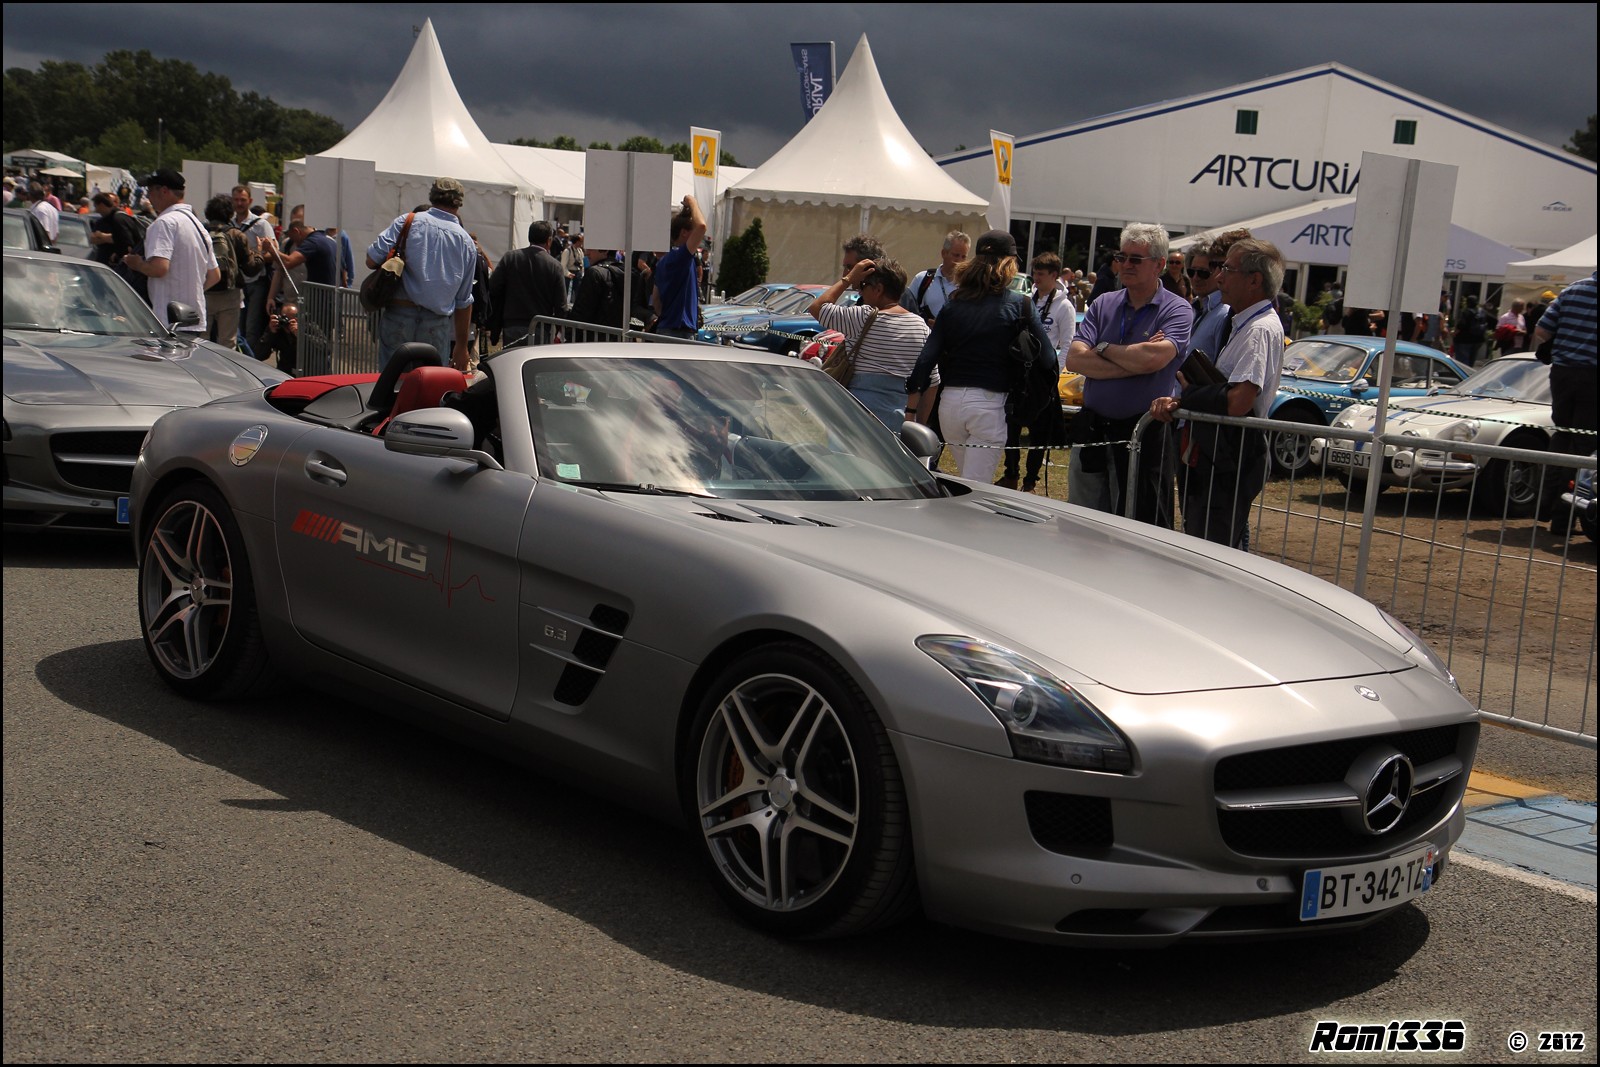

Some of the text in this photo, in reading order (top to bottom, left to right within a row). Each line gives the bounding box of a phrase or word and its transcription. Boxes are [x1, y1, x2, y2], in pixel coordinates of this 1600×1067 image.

[336, 521, 428, 573] AMG
[544, 623, 567, 642] 6.3
[1320, 856, 1425, 910] BT-342-TZ
